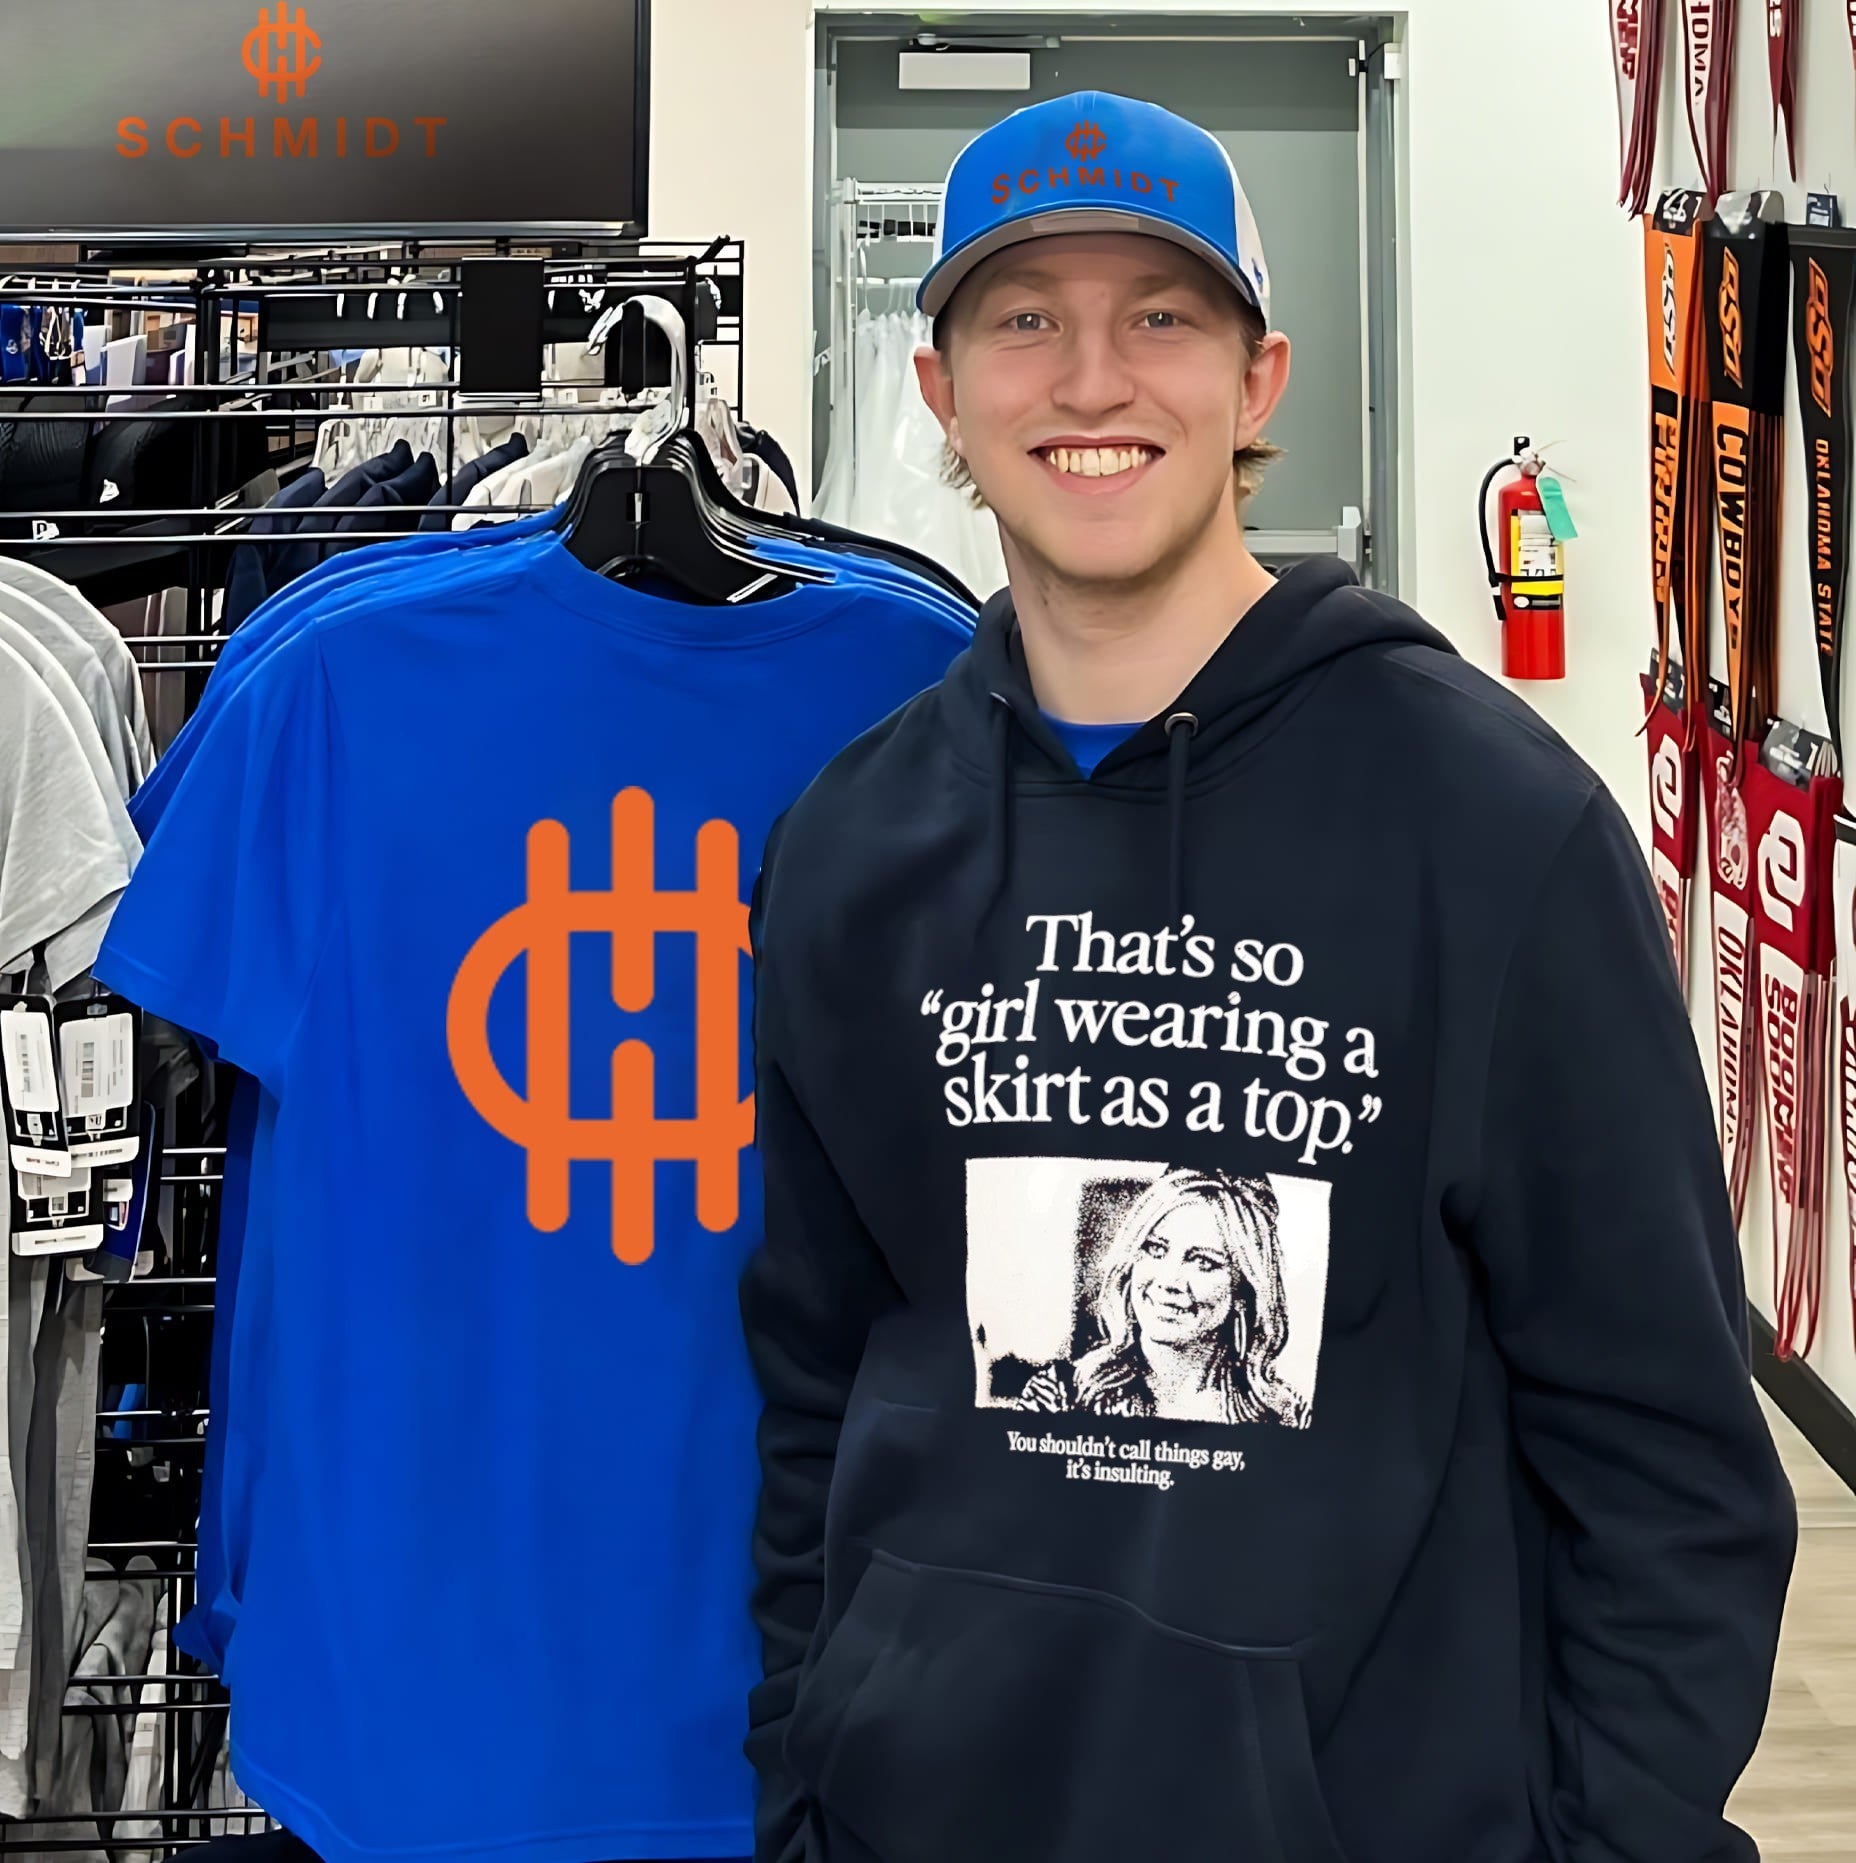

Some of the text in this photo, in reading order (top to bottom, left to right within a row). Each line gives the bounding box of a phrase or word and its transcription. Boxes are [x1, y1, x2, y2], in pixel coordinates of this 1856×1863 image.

[115, 115, 448, 159] SCHMIDT
[991, 166, 1180, 205] SCHMIDT
[1815, 438, 1832, 570] OKLAHOMA
[1025, 911, 1304, 986] That’s so
[920, 978, 1379, 1081] “girl wearing a
[944, 1051, 1383, 1165] skirt as a top.”
[1007, 1431, 1245, 1471] You shouldn’t call things gay,
[1066, 1458, 1175, 1491] it’s insulting.
